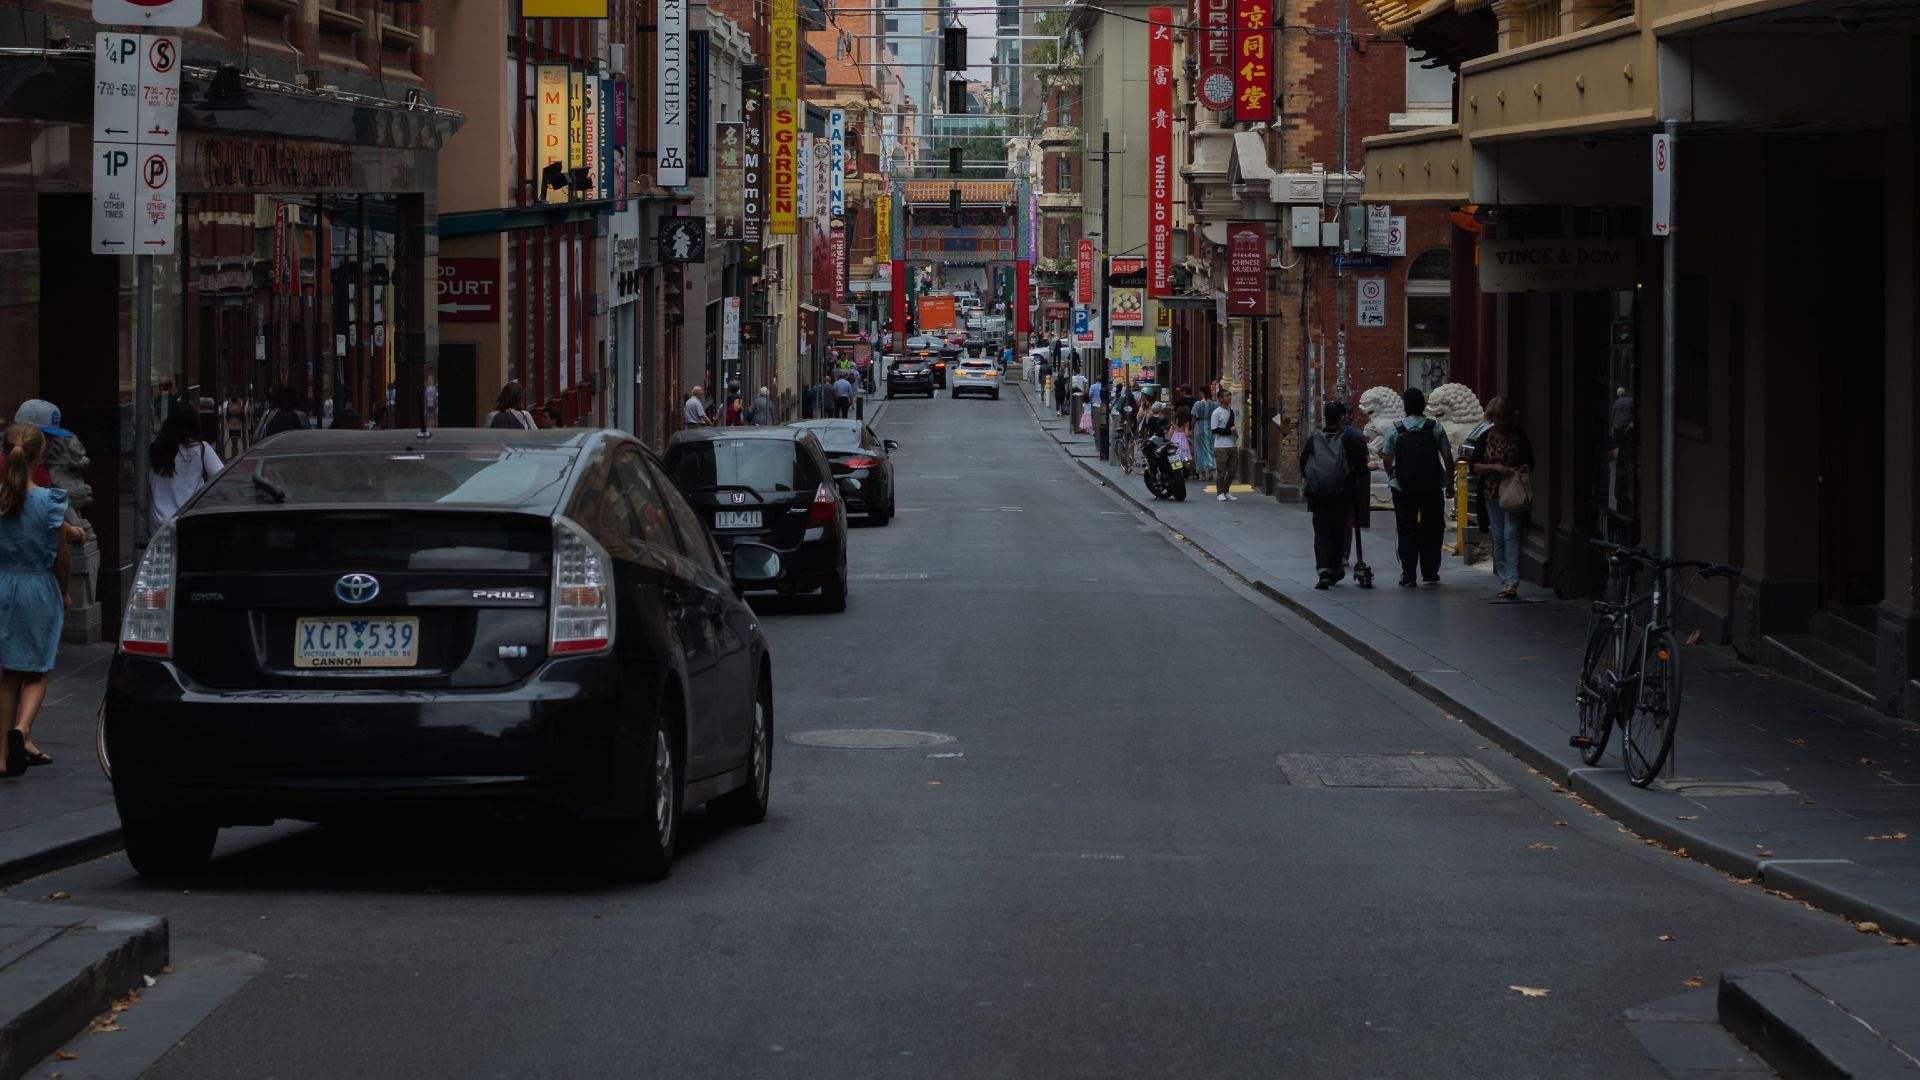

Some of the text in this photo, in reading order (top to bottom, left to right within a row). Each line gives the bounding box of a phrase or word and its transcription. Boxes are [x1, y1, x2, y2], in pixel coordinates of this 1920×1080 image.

[664, 32, 680, 126] KITCHEN
[102, 151, 129, 176] 1P
[831, 113, 843, 216] PARKING
[775, 130, 793, 214] GARDEN
[109, 192, 120, 200] ALL
[152, 194, 162, 202] ALL
[103, 201, 125, 210] OTHER
[146, 202, 167, 211] OTHER
[105, 210, 123, 218] TIMES
[147, 211, 165, 220] TIMES
[1155, 155, 1166, 289] EMPRESS OF CHINA
[1495, 248, 1553, 264] VINCE
[1558, 247, 1571, 264] &
[835, 240, 845, 298] TEPPANYAKI
[188, 593, 224, 601] TOYOTA
[472, 590, 535, 599] PRIUS
[303, 624, 412, 650] XCR 539
[312, 658, 362, 666] CANNON
